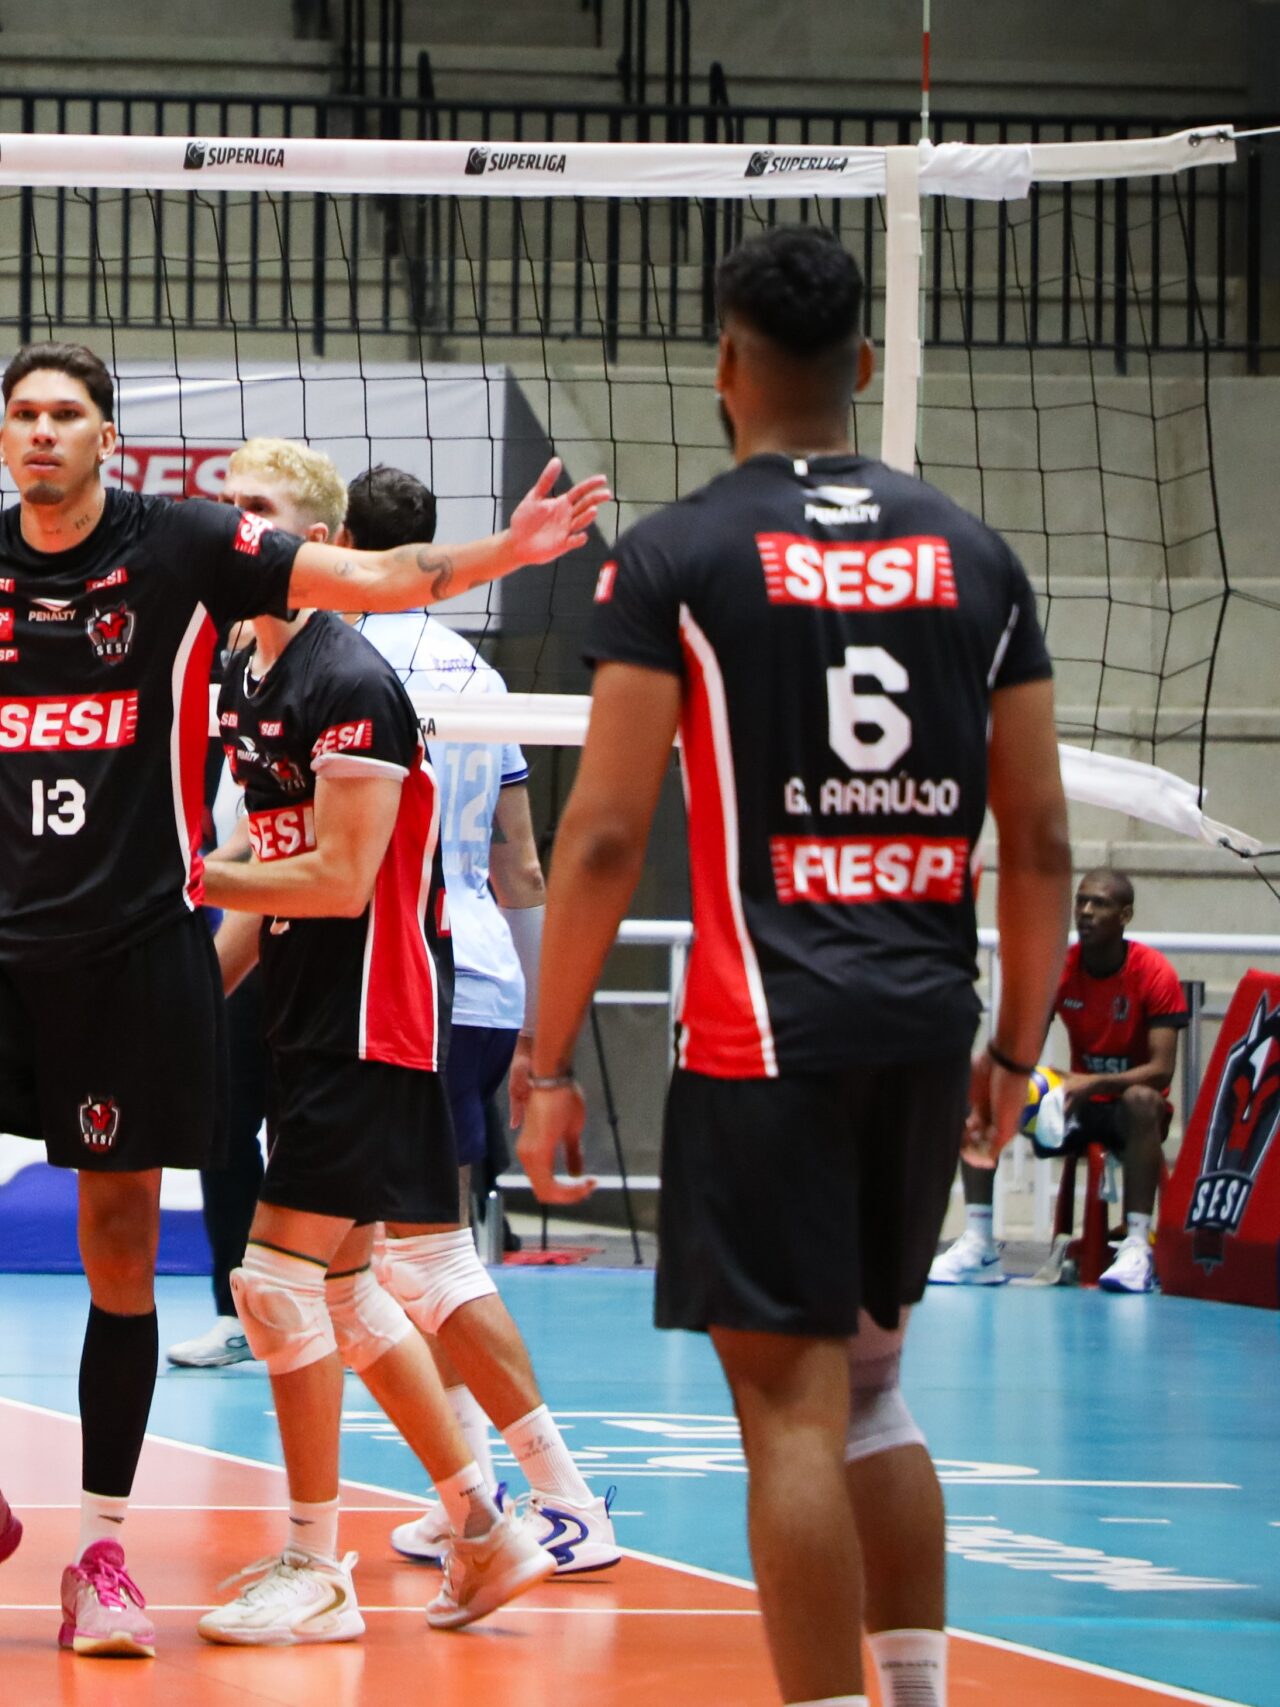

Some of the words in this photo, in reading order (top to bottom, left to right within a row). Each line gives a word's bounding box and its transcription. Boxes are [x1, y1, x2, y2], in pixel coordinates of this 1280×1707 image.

[207, 147, 285, 168] SUPERLIGA
[488, 152, 567, 173] SUPERLIGA
[768, 156, 849, 174] SUPERLIGA
[100, 454, 231, 498] SES
[784, 543, 936, 605] SESI
[28, 609, 77, 621] PENALTY
[96, 643, 129, 656] SESI
[826, 646, 912, 772] 6
[31, 778, 87, 836] 13
[443, 750, 493, 842] 12
[792, 843, 955, 896] FIESP
[1191, 1178, 1248, 1225] SESI
